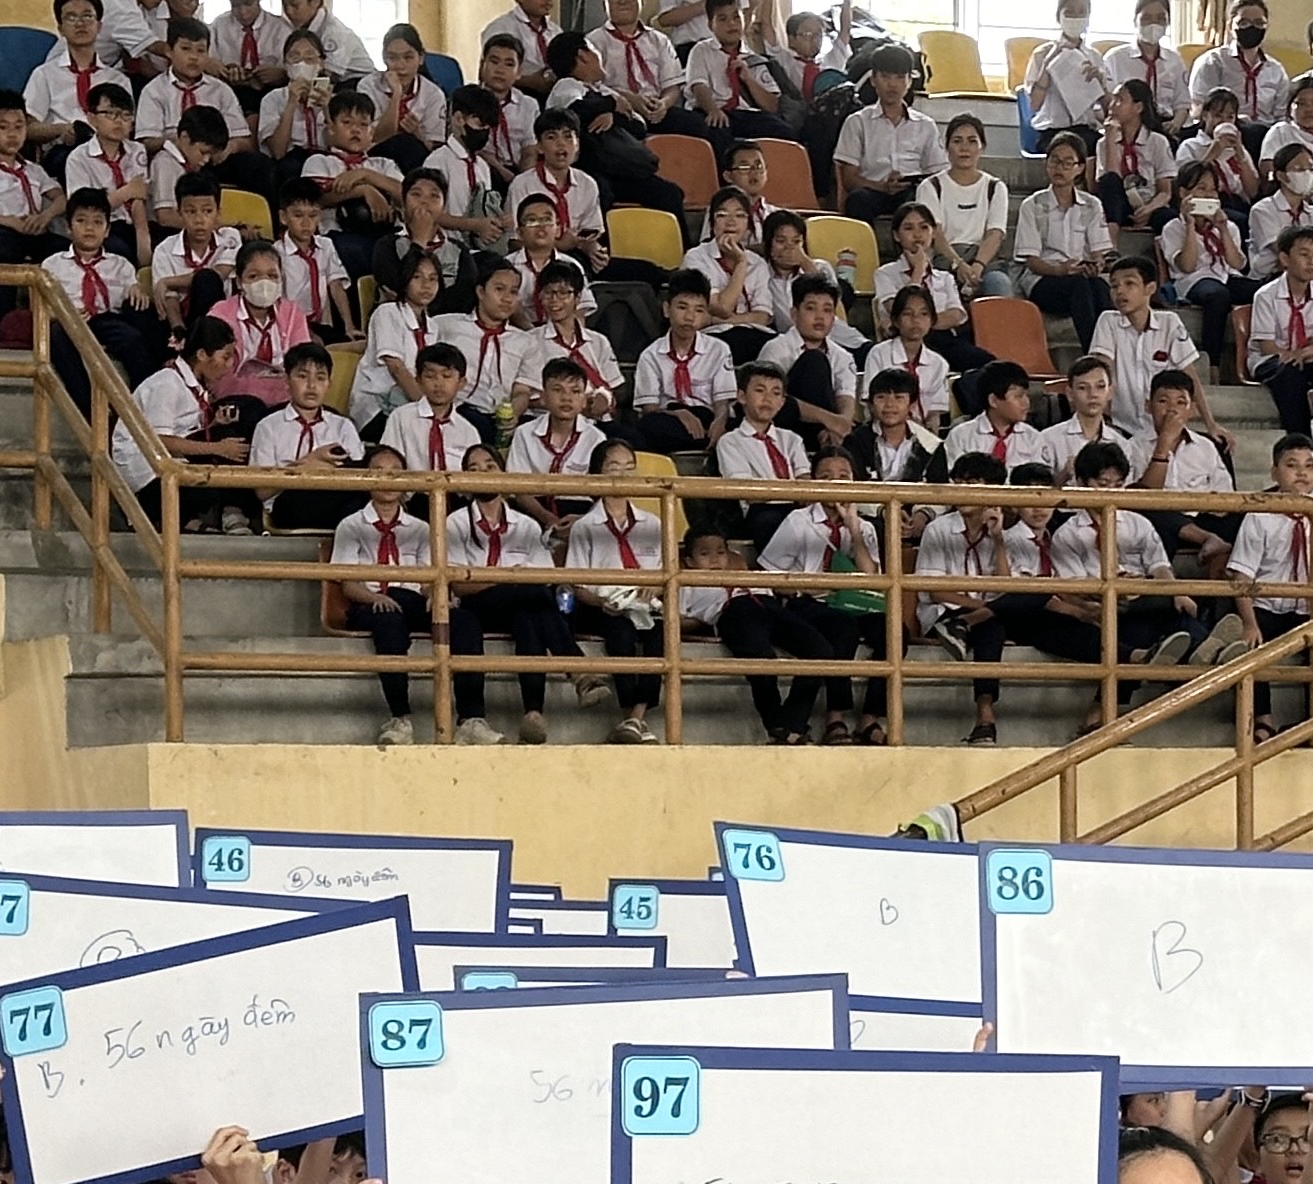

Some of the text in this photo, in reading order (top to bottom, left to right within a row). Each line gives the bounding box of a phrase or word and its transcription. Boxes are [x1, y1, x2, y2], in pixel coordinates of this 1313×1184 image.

[208, 847, 245, 873] 46
[733, 843, 777, 871] 76
[996, 865, 1045, 901] 86
[619, 895, 653, 920] 45
[880, 898, 899, 925] B
[1151, 920, 1204, 994] B
[9, 1001, 56, 1042] 77
[380, 1018, 433, 1052] 87
[104, 1019, 146, 1068] 56
[632, 1076, 690, 1119] 97
